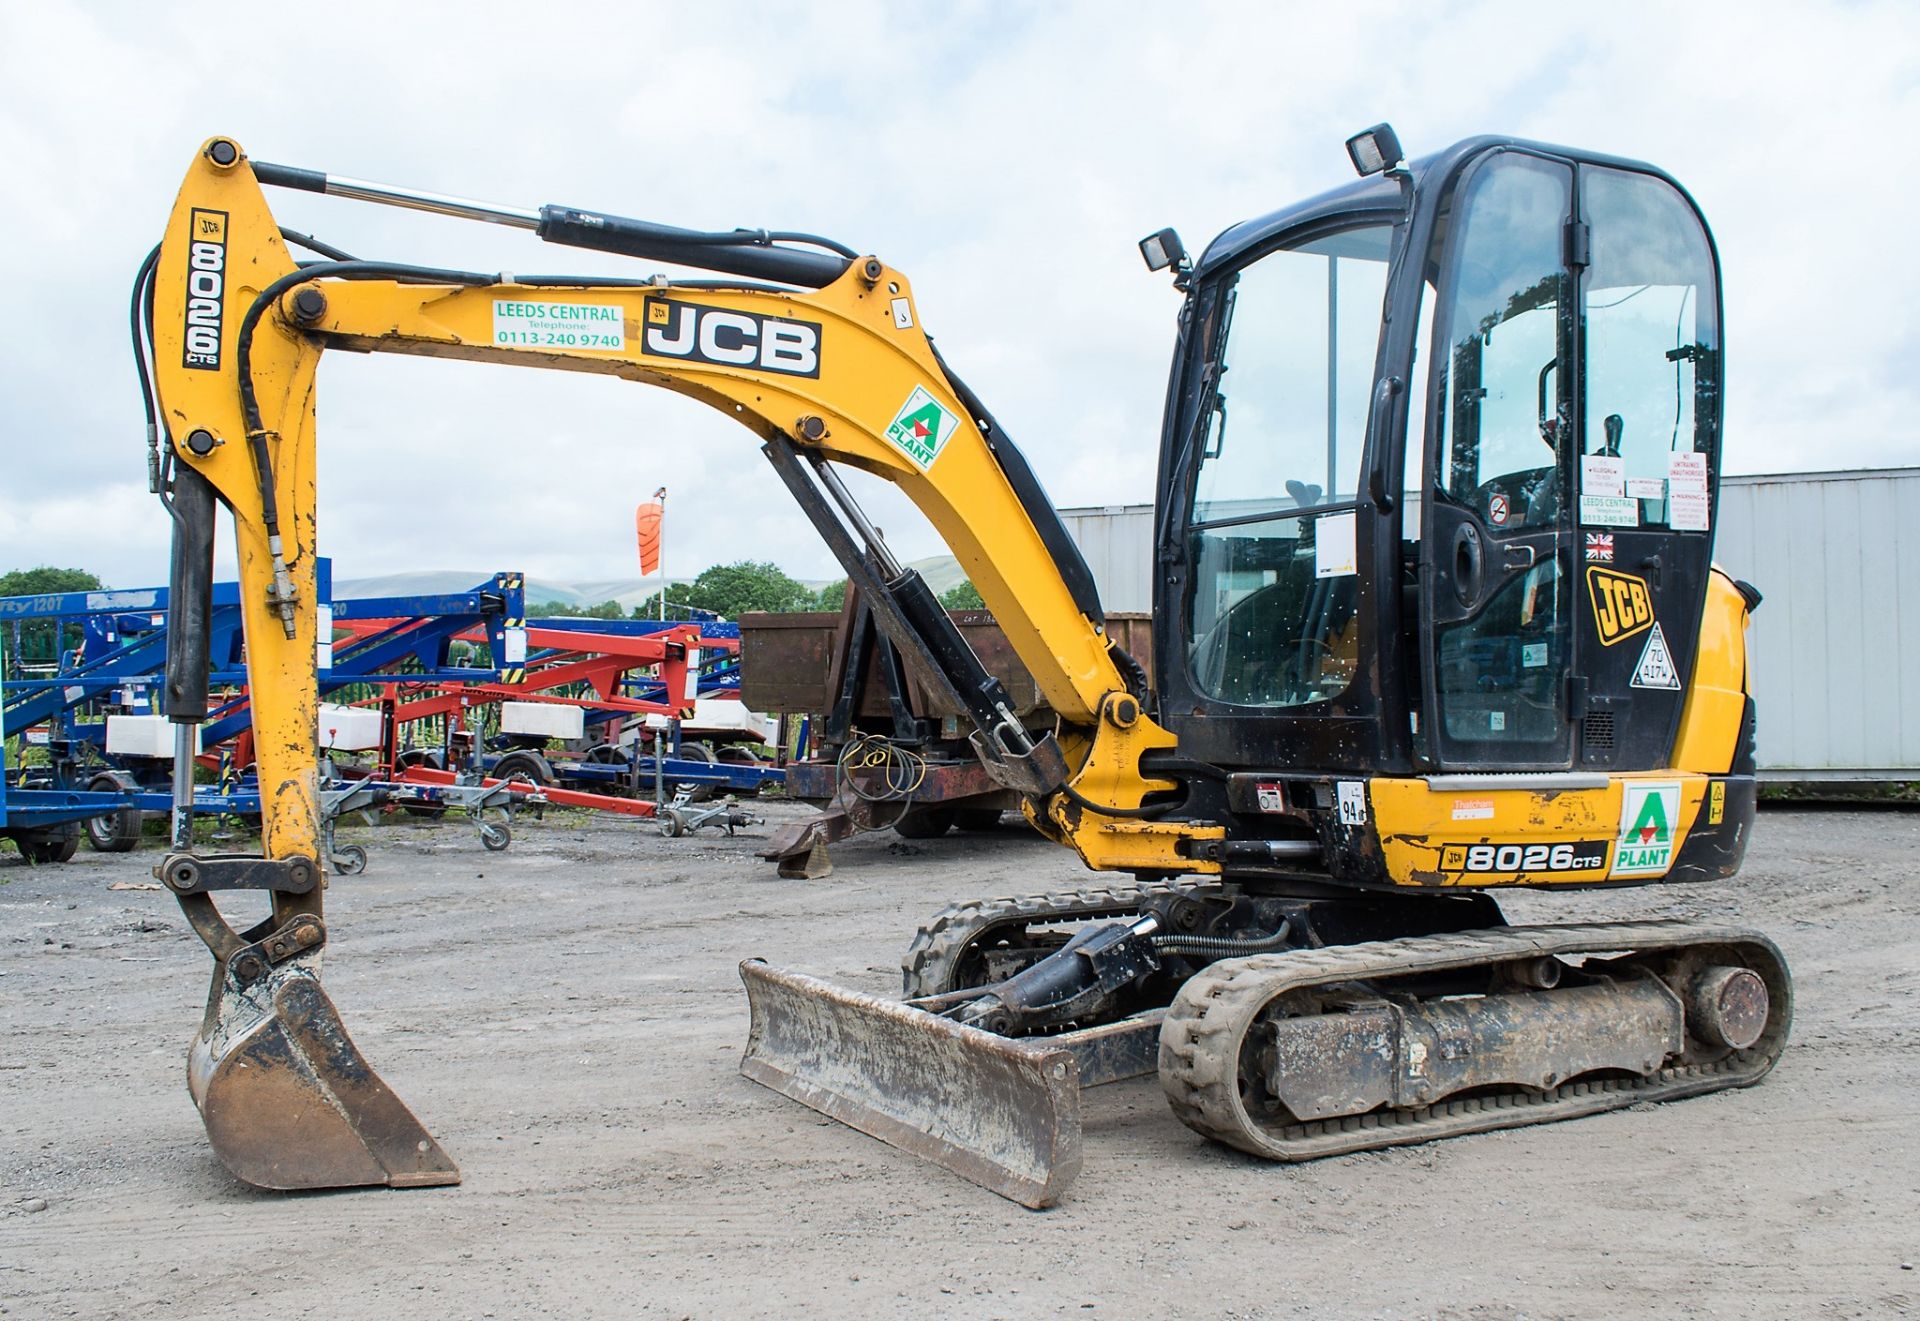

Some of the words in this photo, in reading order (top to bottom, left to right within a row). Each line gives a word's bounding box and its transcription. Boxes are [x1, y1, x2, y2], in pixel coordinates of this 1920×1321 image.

[202, 220, 219, 234] JCB
[186, 242, 225, 354] 8026
[497, 302, 545, 319] LEEDS
[549, 304, 619, 322] CENTRAL
[528, 320, 590, 334] Telephone:
[498, 331, 576, 346] 0113-240
[580, 333, 620, 348] 9740
[647, 306, 817, 374] JCB
[186, 353, 218, 365] CTS
[888, 423, 934, 464] PLANT
[1583, 497, 1603, 507] LEEDS
[1605, 498, 1635, 509] CENTRAL
[33, 596, 65, 613] 120T
[1597, 576, 1649, 638] JCB
[1343, 800, 1356, 821] 94
[1448, 852, 1462, 865] JCB
[1466, 845, 1573, 871] 8026
[1572, 855, 1602, 868] CTS
[1617, 848, 1670, 867] PLANT
